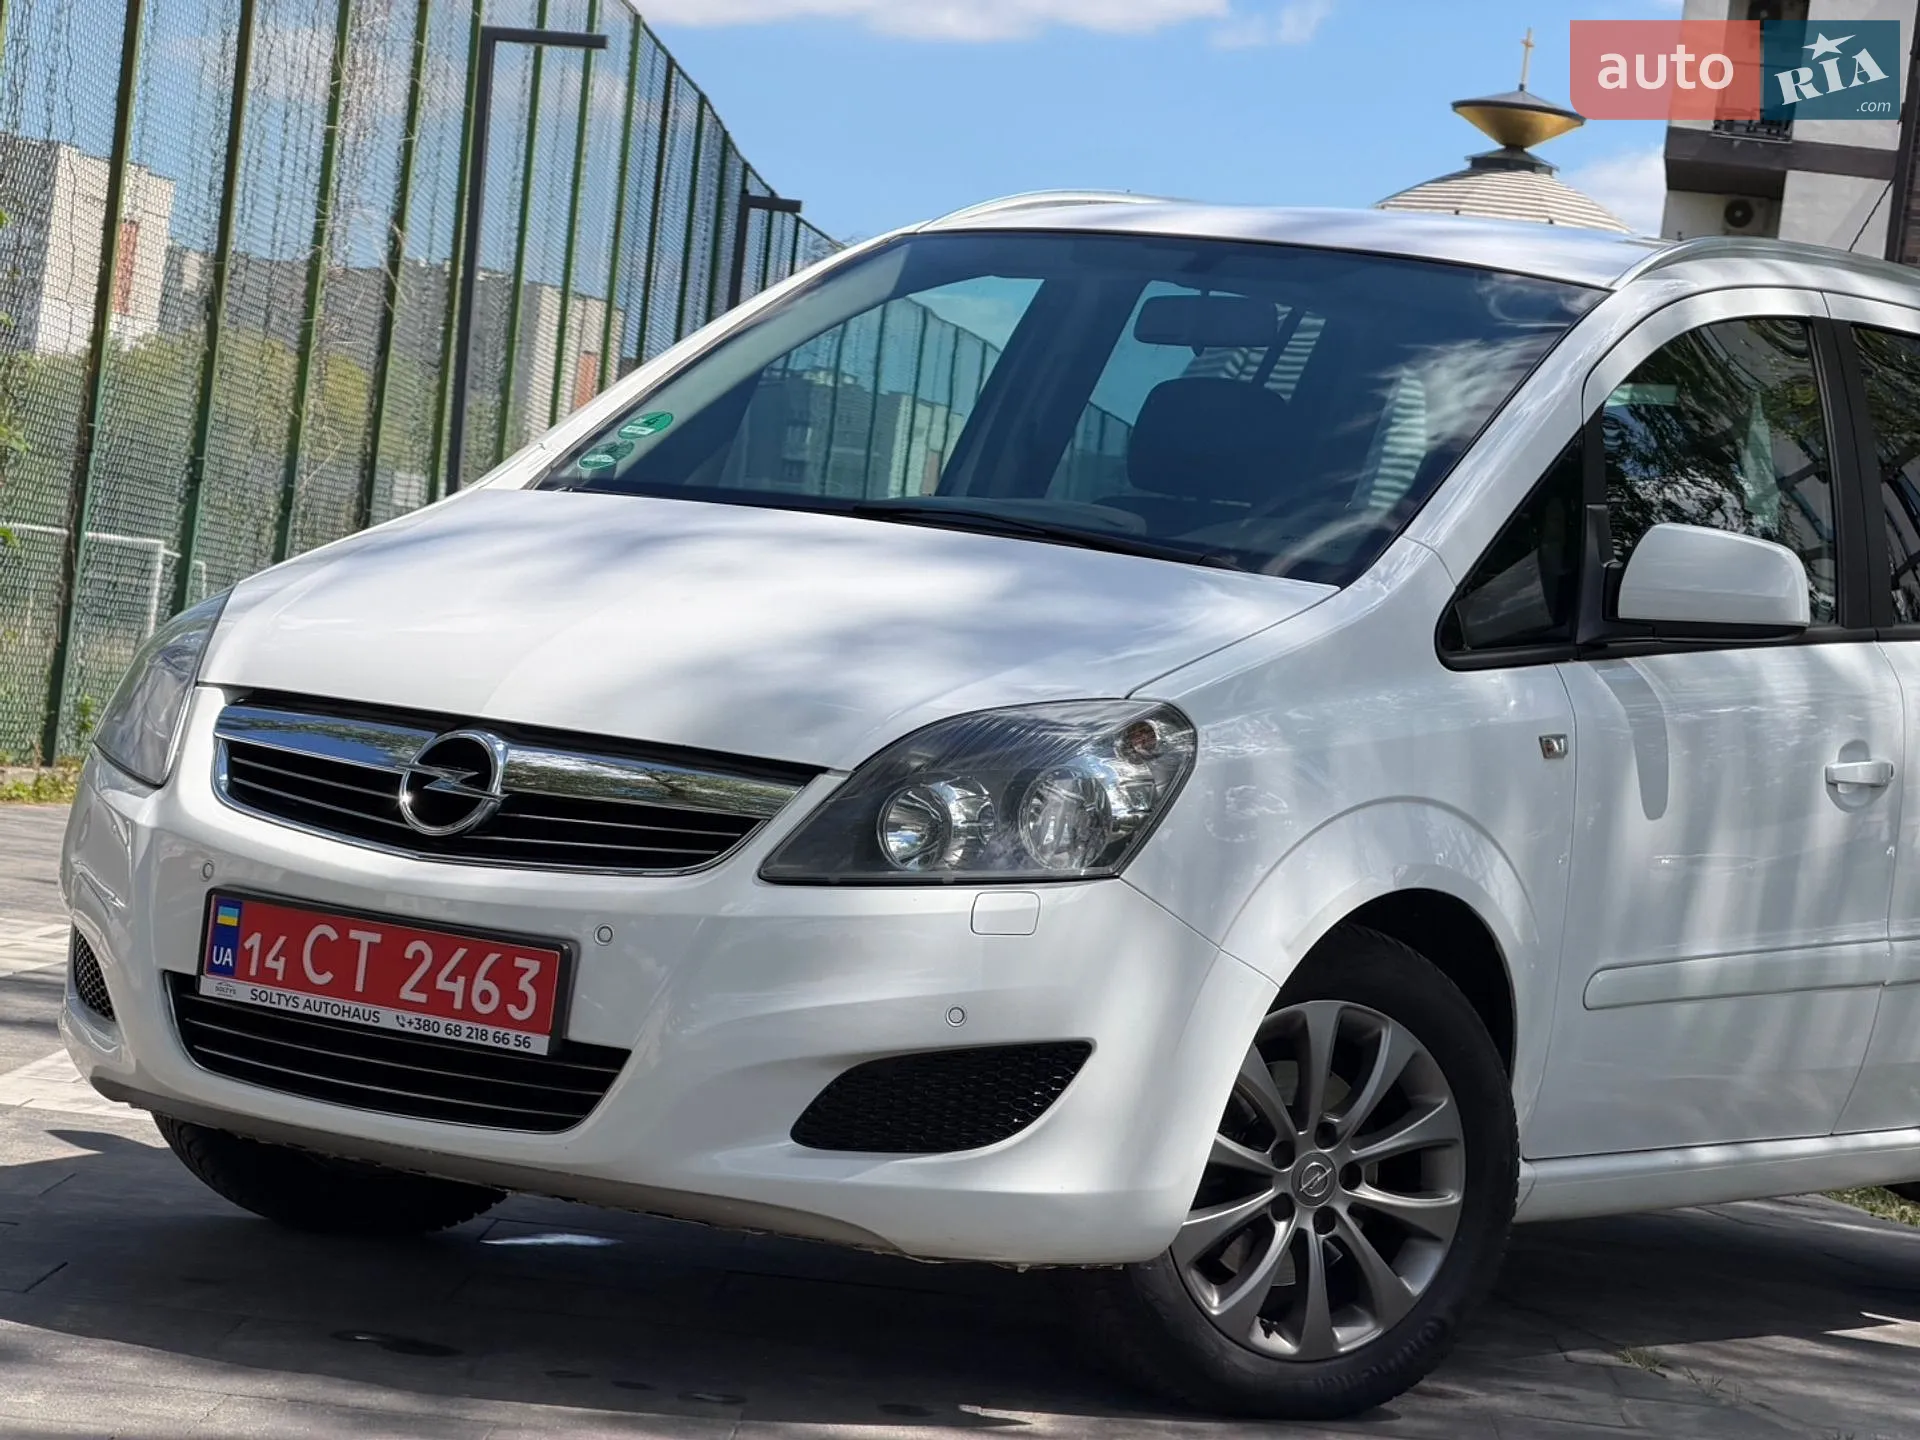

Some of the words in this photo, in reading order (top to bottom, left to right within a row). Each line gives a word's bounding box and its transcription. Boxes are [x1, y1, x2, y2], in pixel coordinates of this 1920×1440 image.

[212, 945, 233, 968] UA
[243, 932, 288, 981] 14
[302, 924, 381, 993] CT
[399, 940, 541, 1021] 2463
[250, 988, 300, 1009] SOLTYS
[302, 999, 380, 1024] AUTOHAUS
[407, 1017, 440, 1034] +380
[444, 1023, 462, 1038] 68
[466, 1026, 489, 1042] 218
[492, 1031, 510, 1046] 66
[513, 1034, 532, 1049] 56
